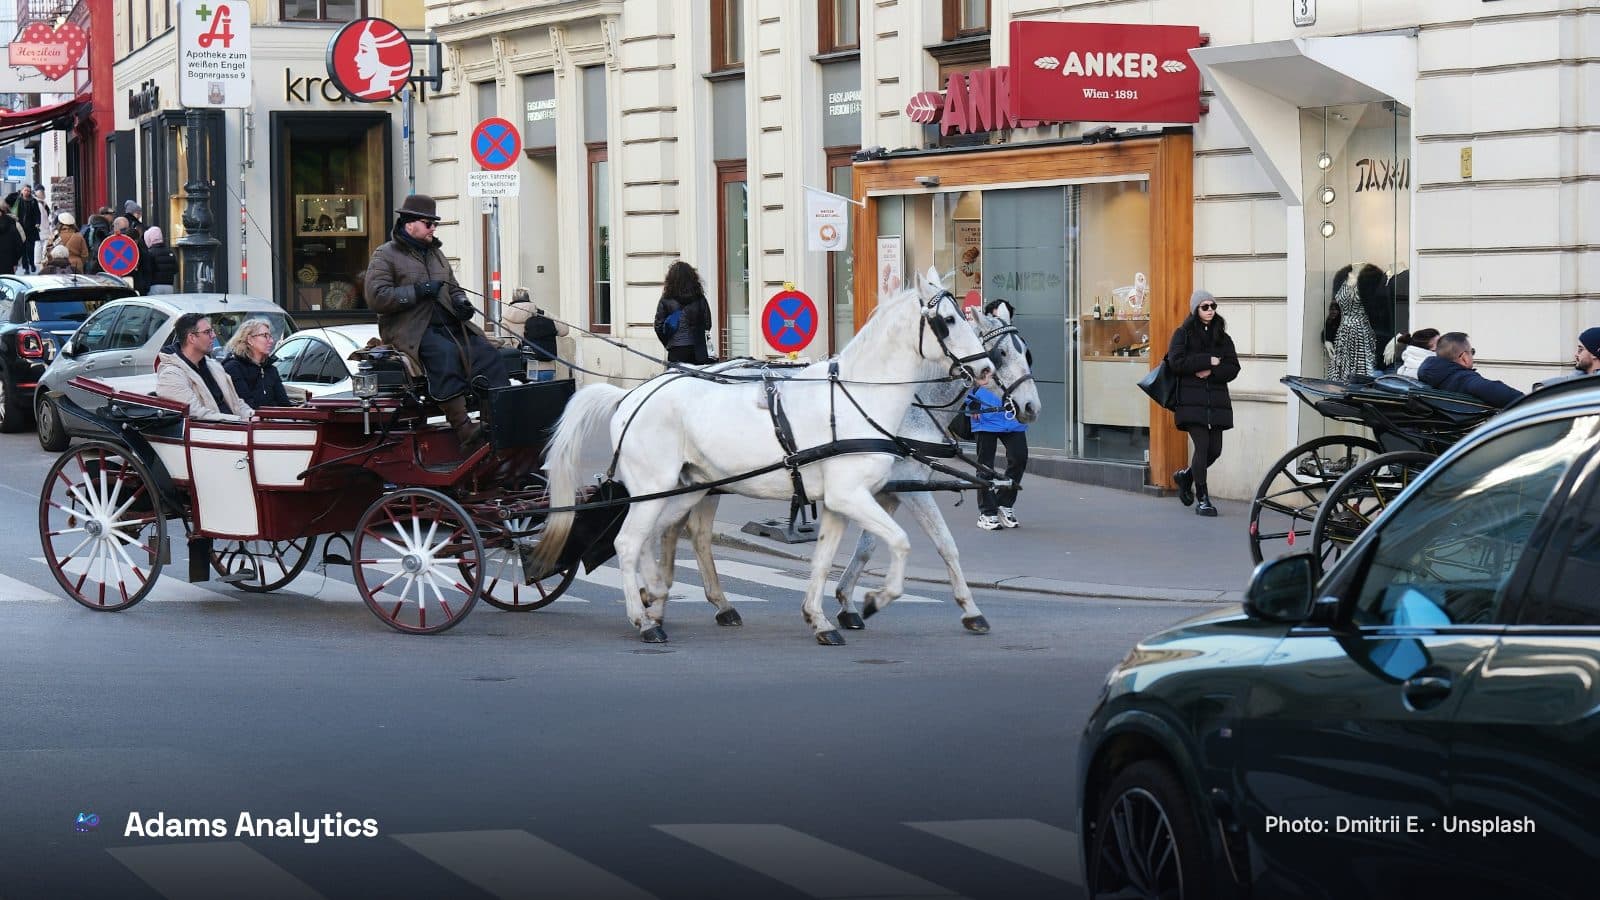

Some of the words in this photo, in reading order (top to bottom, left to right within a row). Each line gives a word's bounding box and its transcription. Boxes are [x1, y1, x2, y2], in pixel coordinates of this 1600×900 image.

[16, 46, 61, 57] Herzilein
[186, 50, 227, 60] Apotheke
[188, 61, 219, 69] weißen
[221, 61, 245, 70] Engel
[1062, 51, 1158, 79] ANKER
[188, 70, 239, 79] Bognergasse
[240, 71, 246, 79] 9
[1083, 89, 1109, 98] Wien
[1116, 91, 1137, 99] 1891
[941, 66, 1046, 137] ANK
[1006, 271, 1047, 291] ANKER
